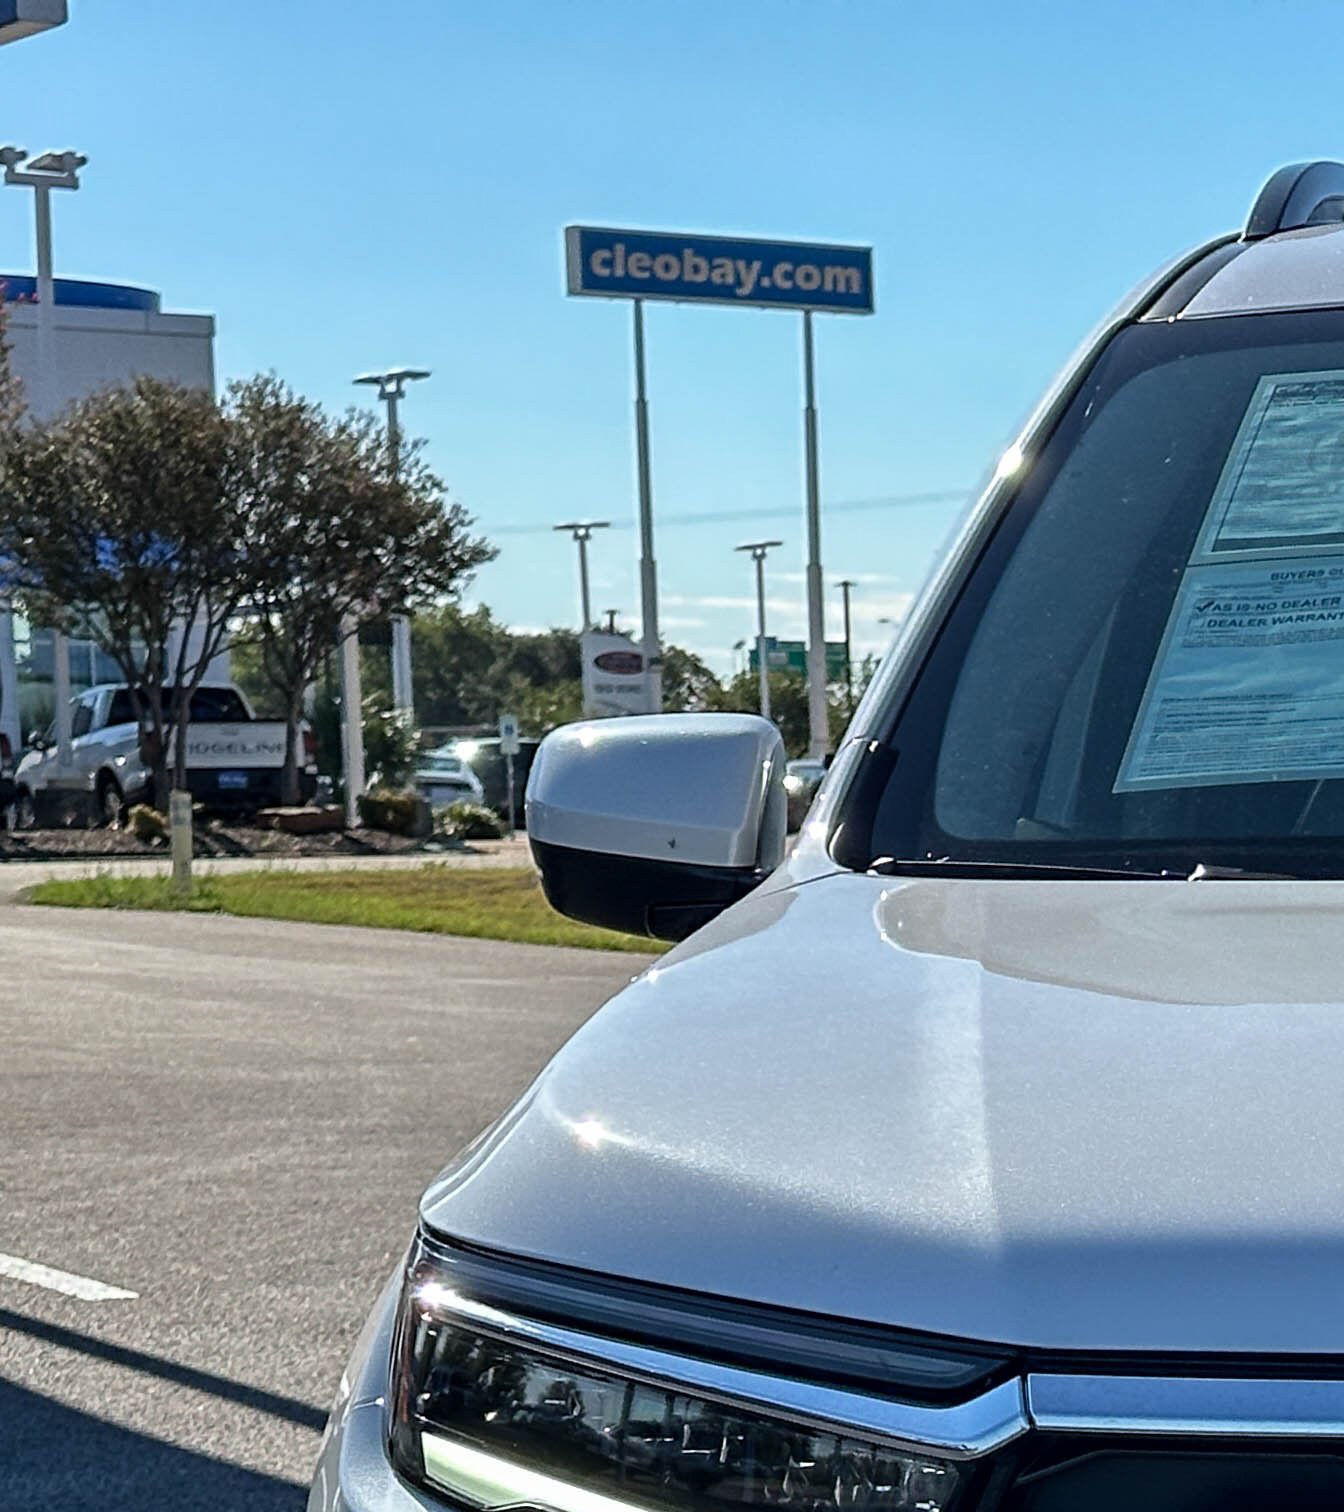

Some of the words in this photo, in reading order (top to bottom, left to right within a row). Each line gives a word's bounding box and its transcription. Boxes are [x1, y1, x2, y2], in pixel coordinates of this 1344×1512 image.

[590, 244, 862, 297] cleobay.com
[1270, 569, 1325, 581] BUYERS
[1212, 603, 1234, 612] AS
[1282, 596, 1341, 609] DEALER
[1207, 617, 1268, 629] DEALER
